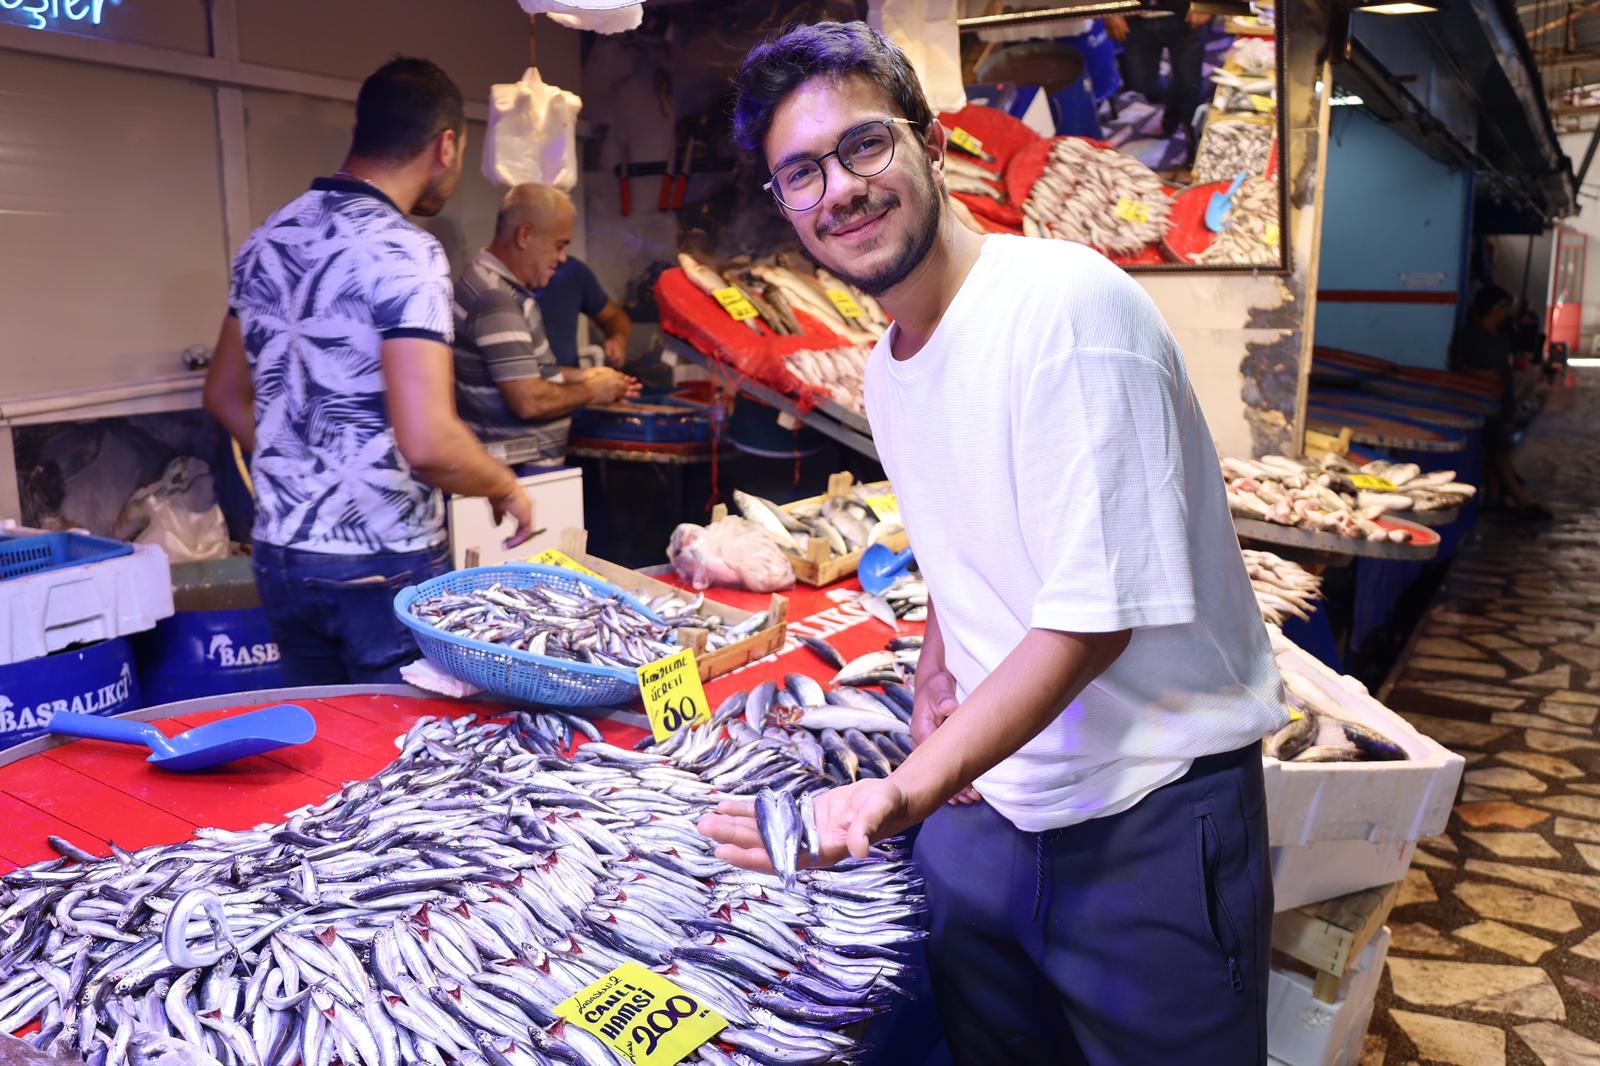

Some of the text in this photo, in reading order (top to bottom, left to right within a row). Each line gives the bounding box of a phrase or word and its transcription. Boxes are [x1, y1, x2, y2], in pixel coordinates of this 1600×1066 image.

[663, 696, 696, 731] 60
[585, 984, 636, 1023] CANLI
[632, 995, 697, 1055] 200
